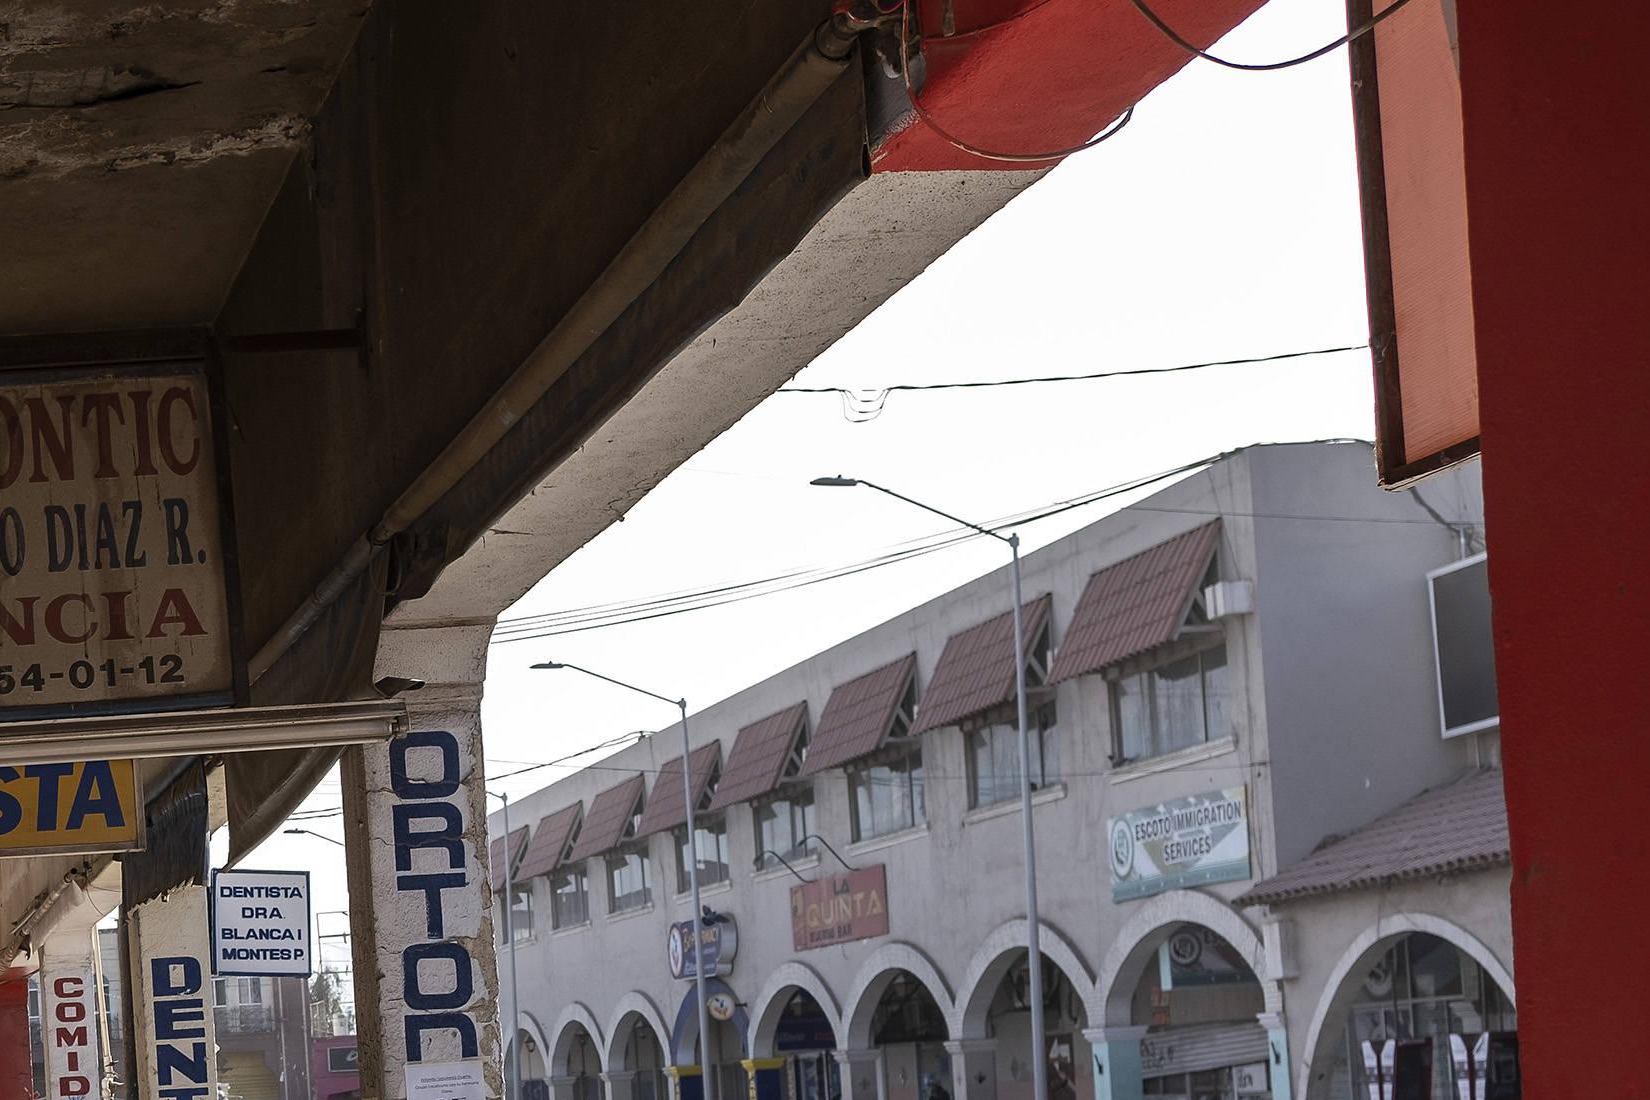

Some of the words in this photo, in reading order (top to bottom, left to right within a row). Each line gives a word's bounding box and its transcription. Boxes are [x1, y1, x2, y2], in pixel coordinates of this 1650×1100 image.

[45, 501, 146, 573] DIAZ
[165, 497, 207, 567] R.
[1135, 817, 1170, 841] ESCOTO
[1173, 801, 1242, 831] IMMIGRATION
[1164, 836, 1211, 861] SERVICES
[220, 886, 303, 898] DENTISTA
[833, 879, 851, 896] LA
[806, 889, 882, 928] QUINTA
[221, 927, 294, 940] BLANCA
[297, 928, 302, 941] I
[222, 947, 291, 960] MONTES
